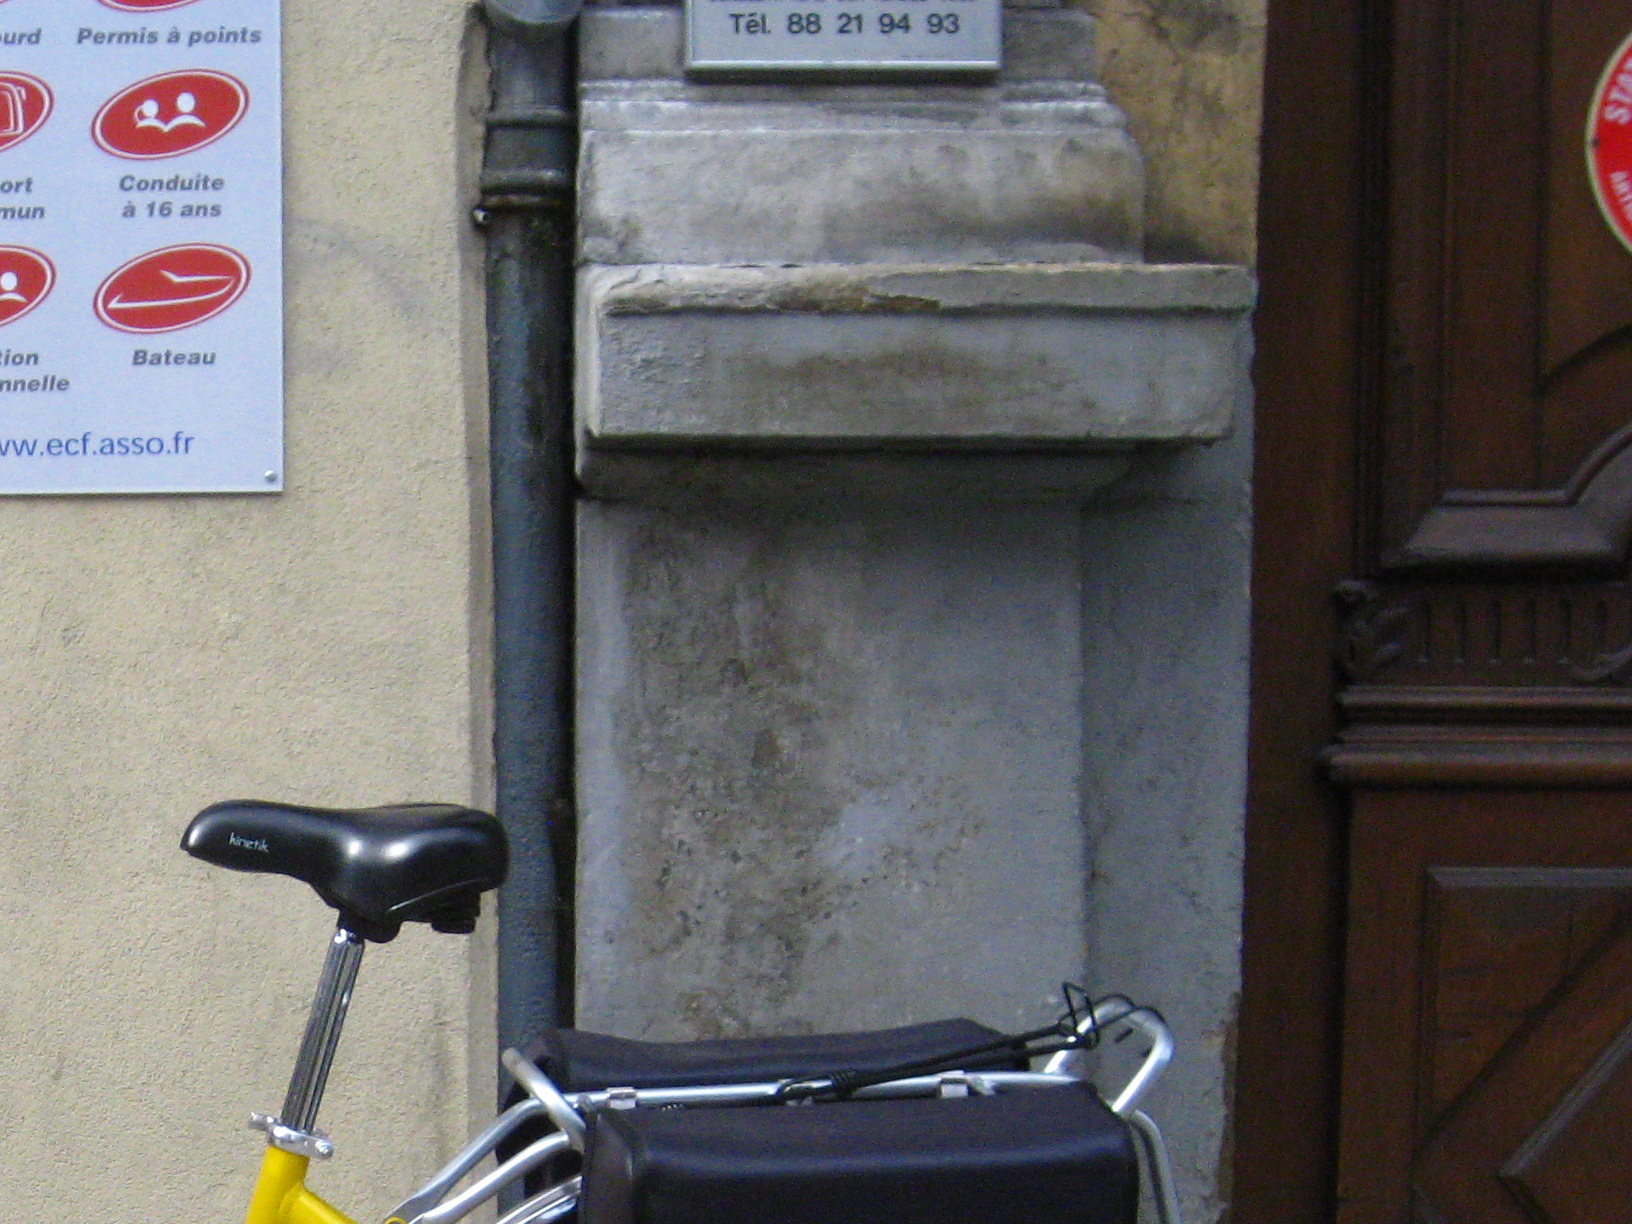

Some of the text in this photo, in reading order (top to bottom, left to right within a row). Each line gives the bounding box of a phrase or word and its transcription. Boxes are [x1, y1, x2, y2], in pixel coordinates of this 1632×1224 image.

[729, 12, 961, 35] Tél. 88 21 94 93
[76, 25, 262, 47] Permis à points
[119, 174, 225, 192] Conduite
[121, 199, 222, 219] à 16 ans
[132, 349, 216, 366] Bateau
